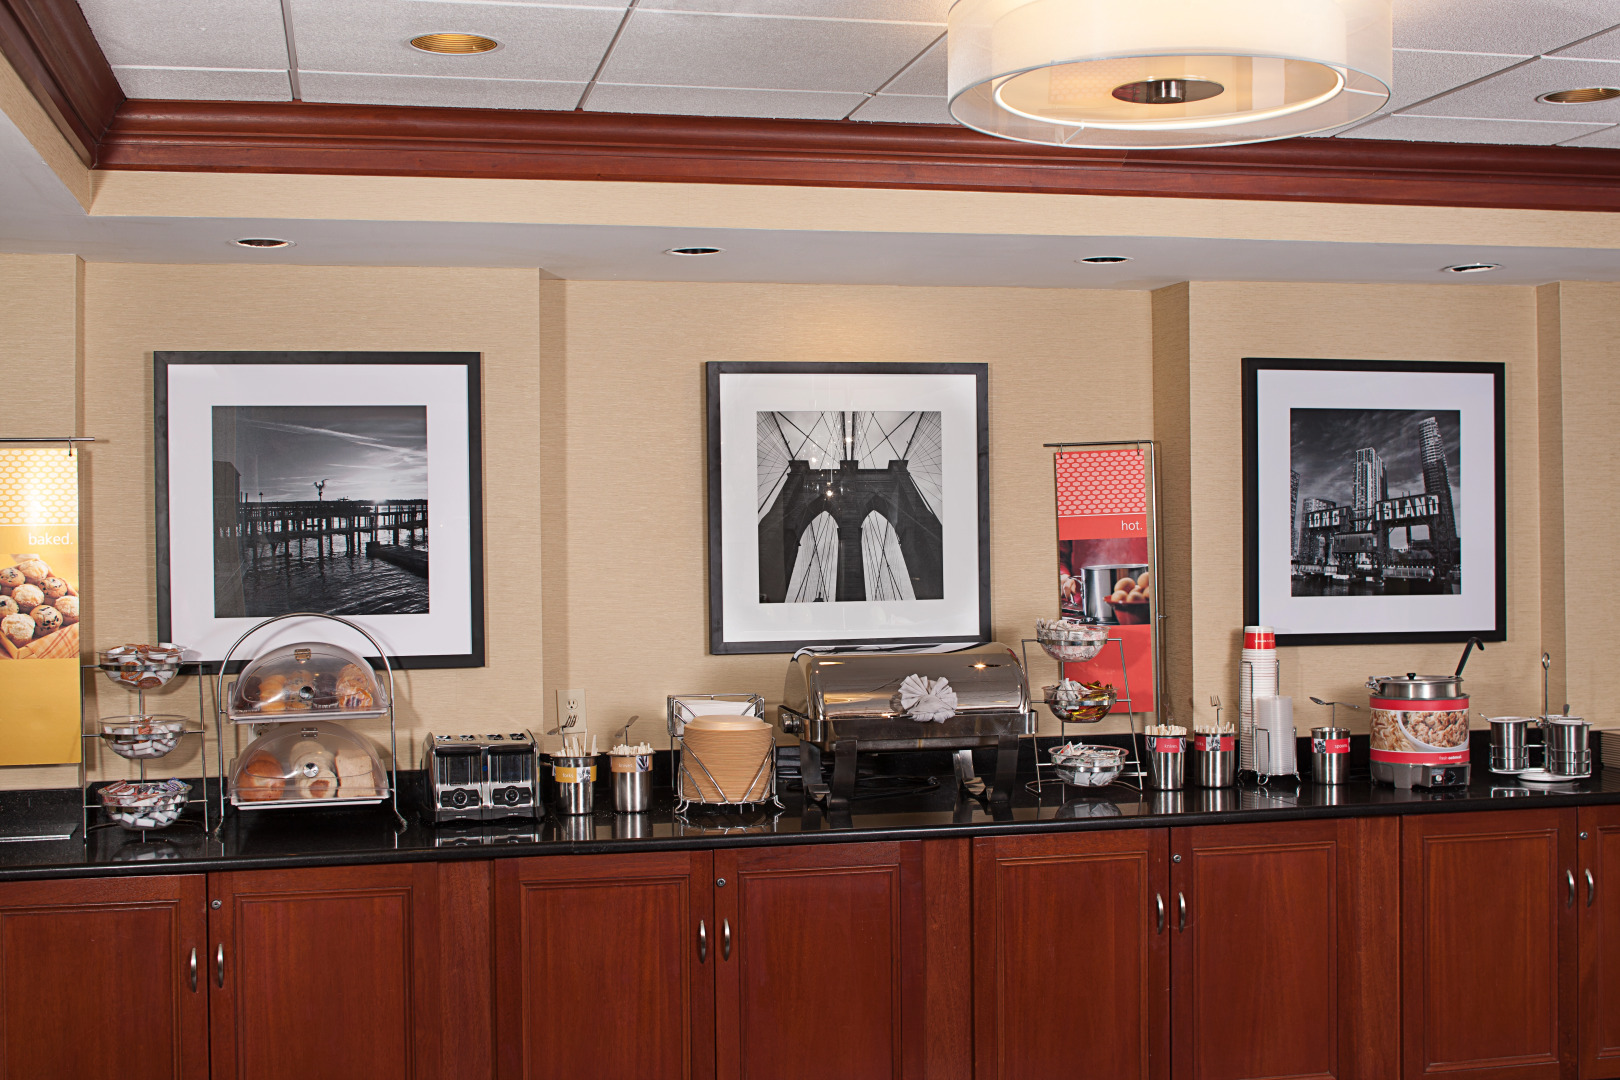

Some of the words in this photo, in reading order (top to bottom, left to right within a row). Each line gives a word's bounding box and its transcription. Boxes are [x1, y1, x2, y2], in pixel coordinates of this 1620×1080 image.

[1308, 510, 1340, 528] LONG
[1376, 495, 1440, 520] ISLAND
[1121, 520, 1143, 531] hot.
[28, 532, 73, 546] baked.
